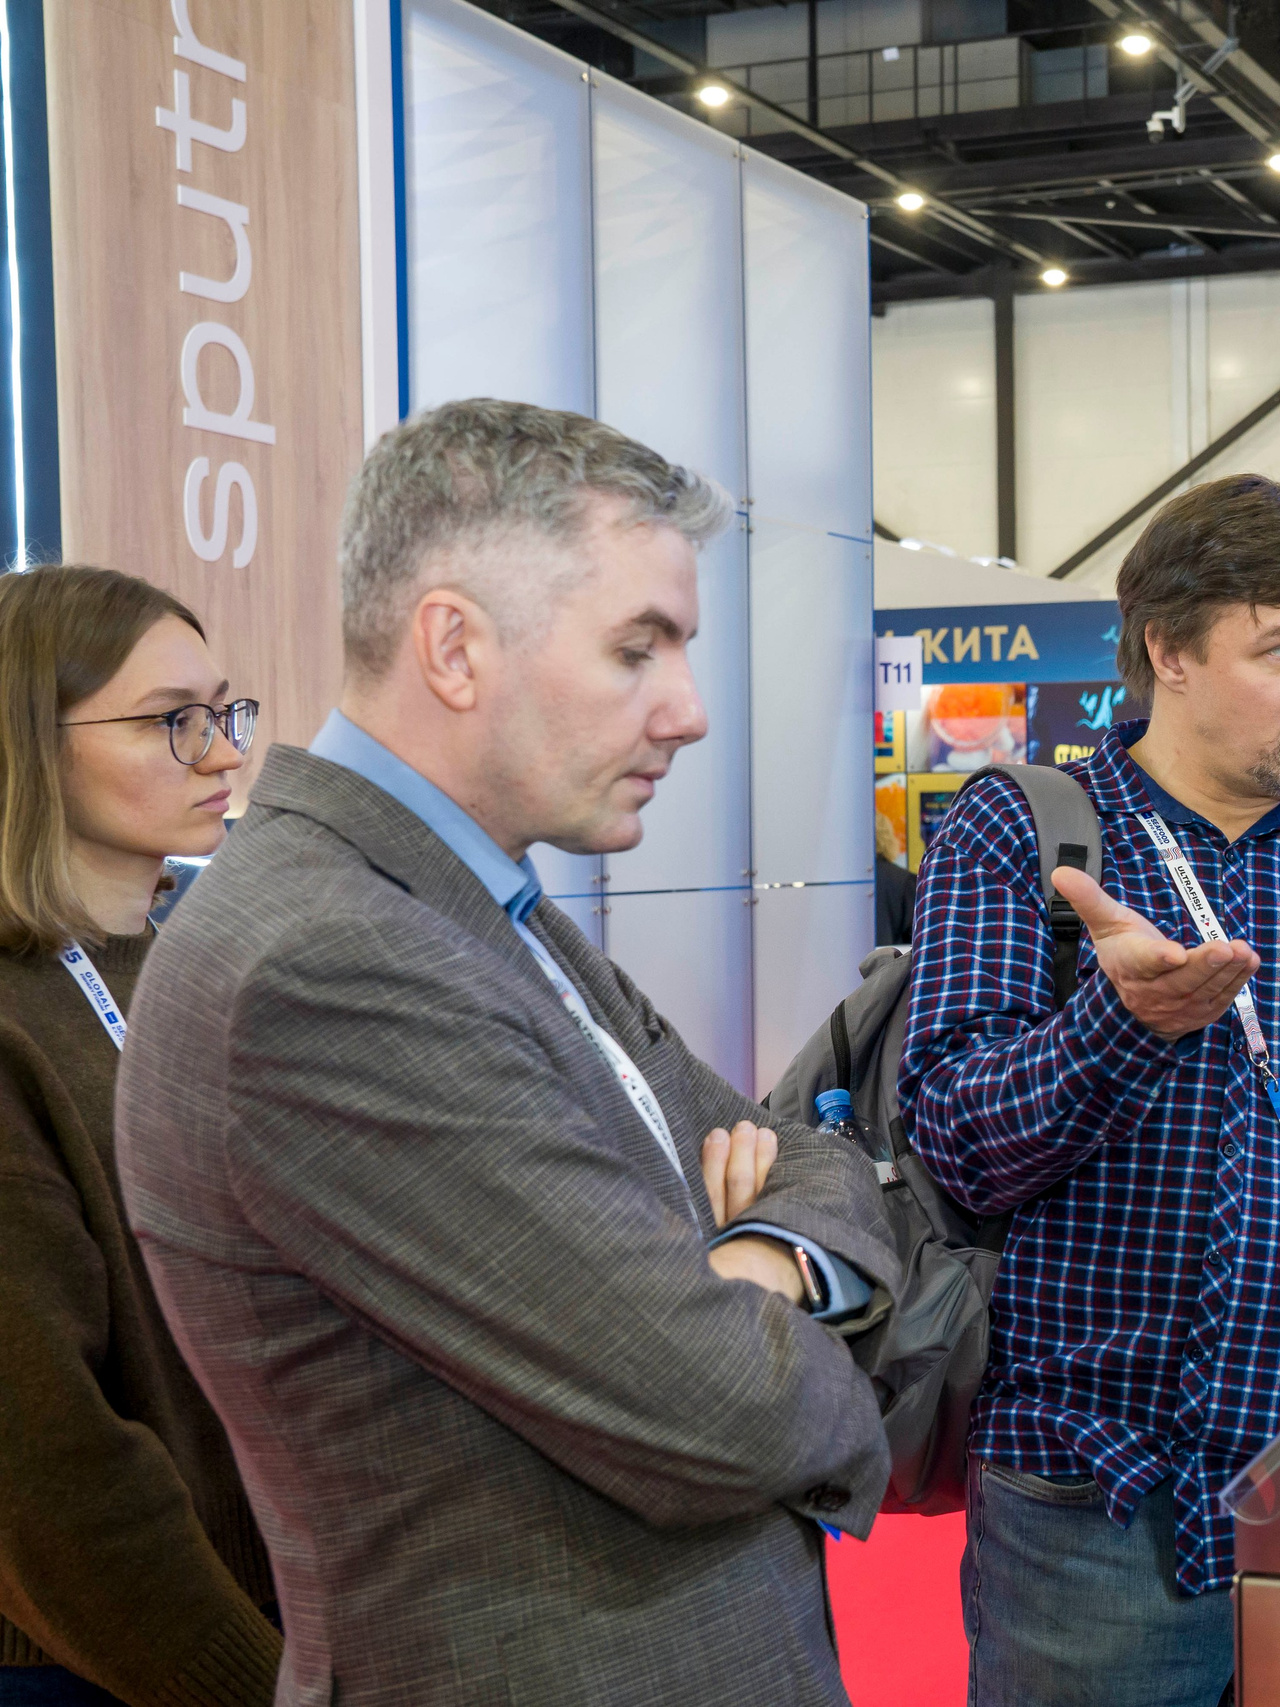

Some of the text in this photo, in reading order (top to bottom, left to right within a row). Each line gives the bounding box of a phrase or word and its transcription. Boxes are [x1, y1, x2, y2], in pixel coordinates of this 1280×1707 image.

[879, 662, 912, 684] T11
[1150, 818, 1170, 845] SEAFOOD
[1177, 865, 1204, 911] ULTRAFISH
[80, 973, 95, 993] FISHERY
[85, 971, 111, 1010] GLOBAL
